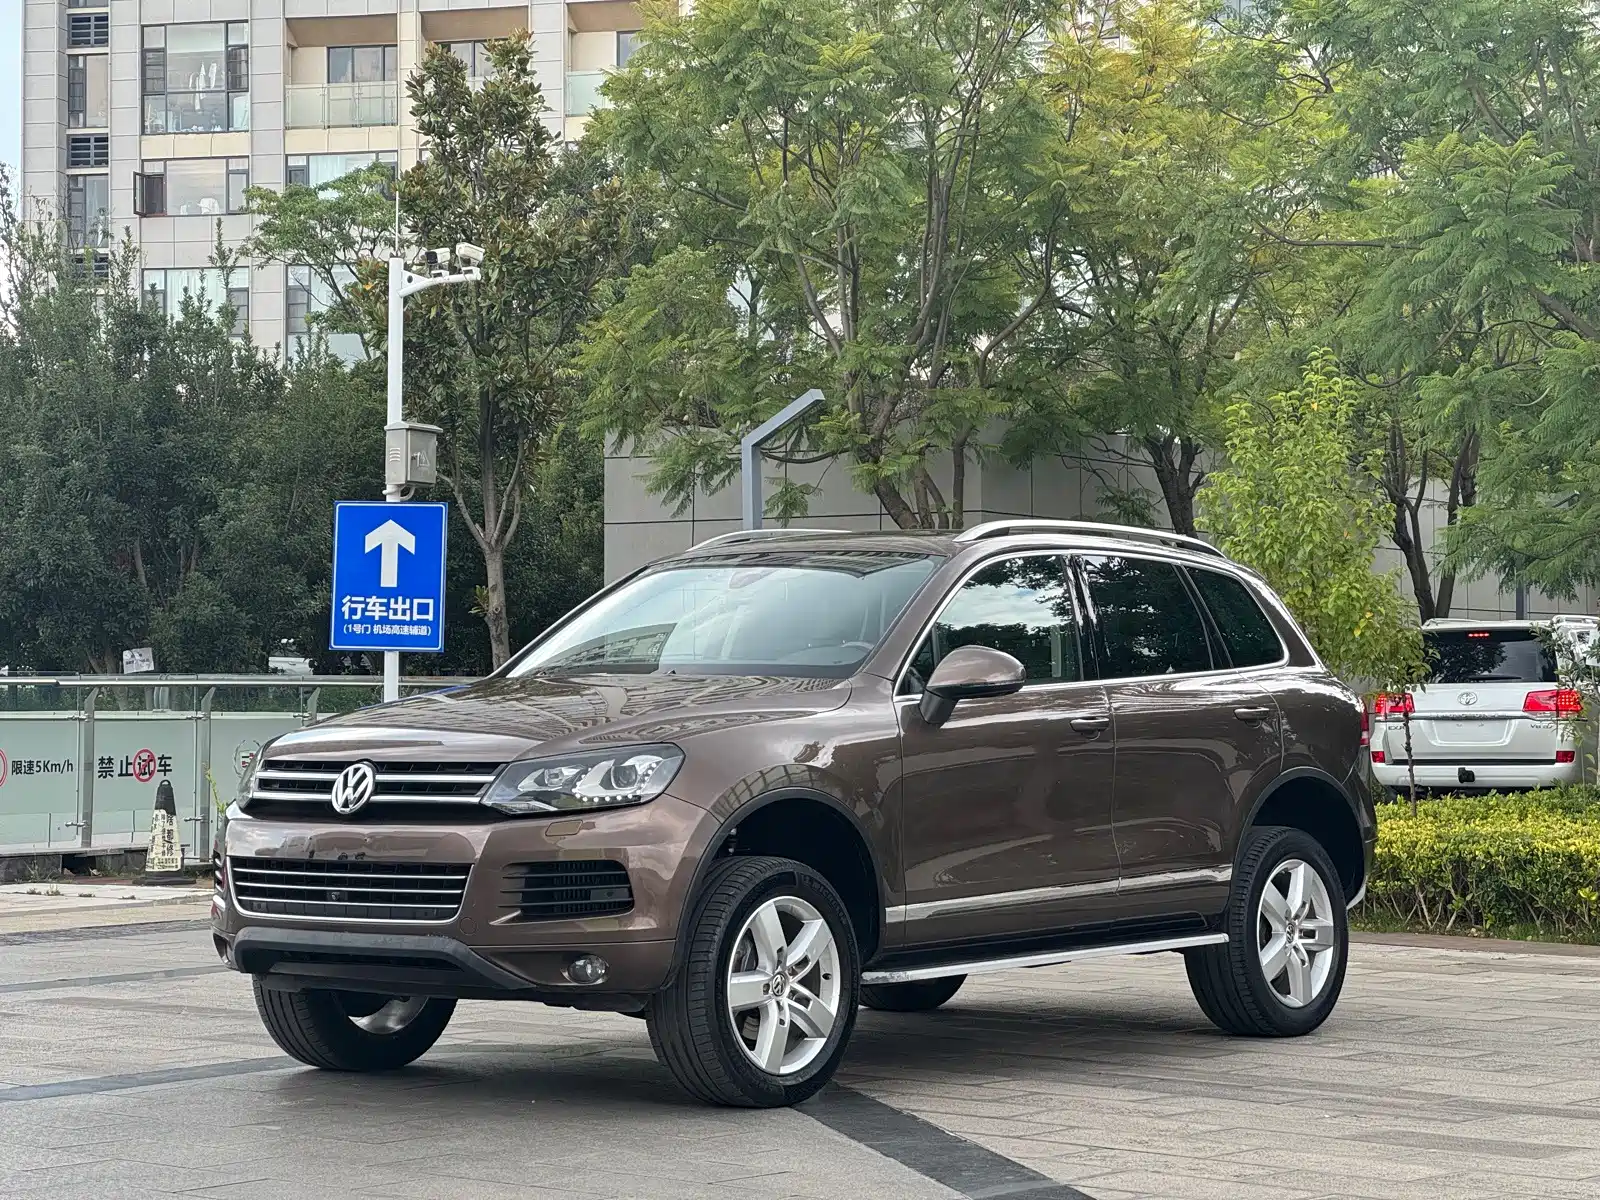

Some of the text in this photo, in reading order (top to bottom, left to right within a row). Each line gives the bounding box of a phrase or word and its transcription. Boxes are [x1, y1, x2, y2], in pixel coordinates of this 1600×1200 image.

[341, 595, 434, 621] 行车出口
[11, 759, 74, 775] 限速5Km/h
[97, 754, 173, 779] 禁止试车
